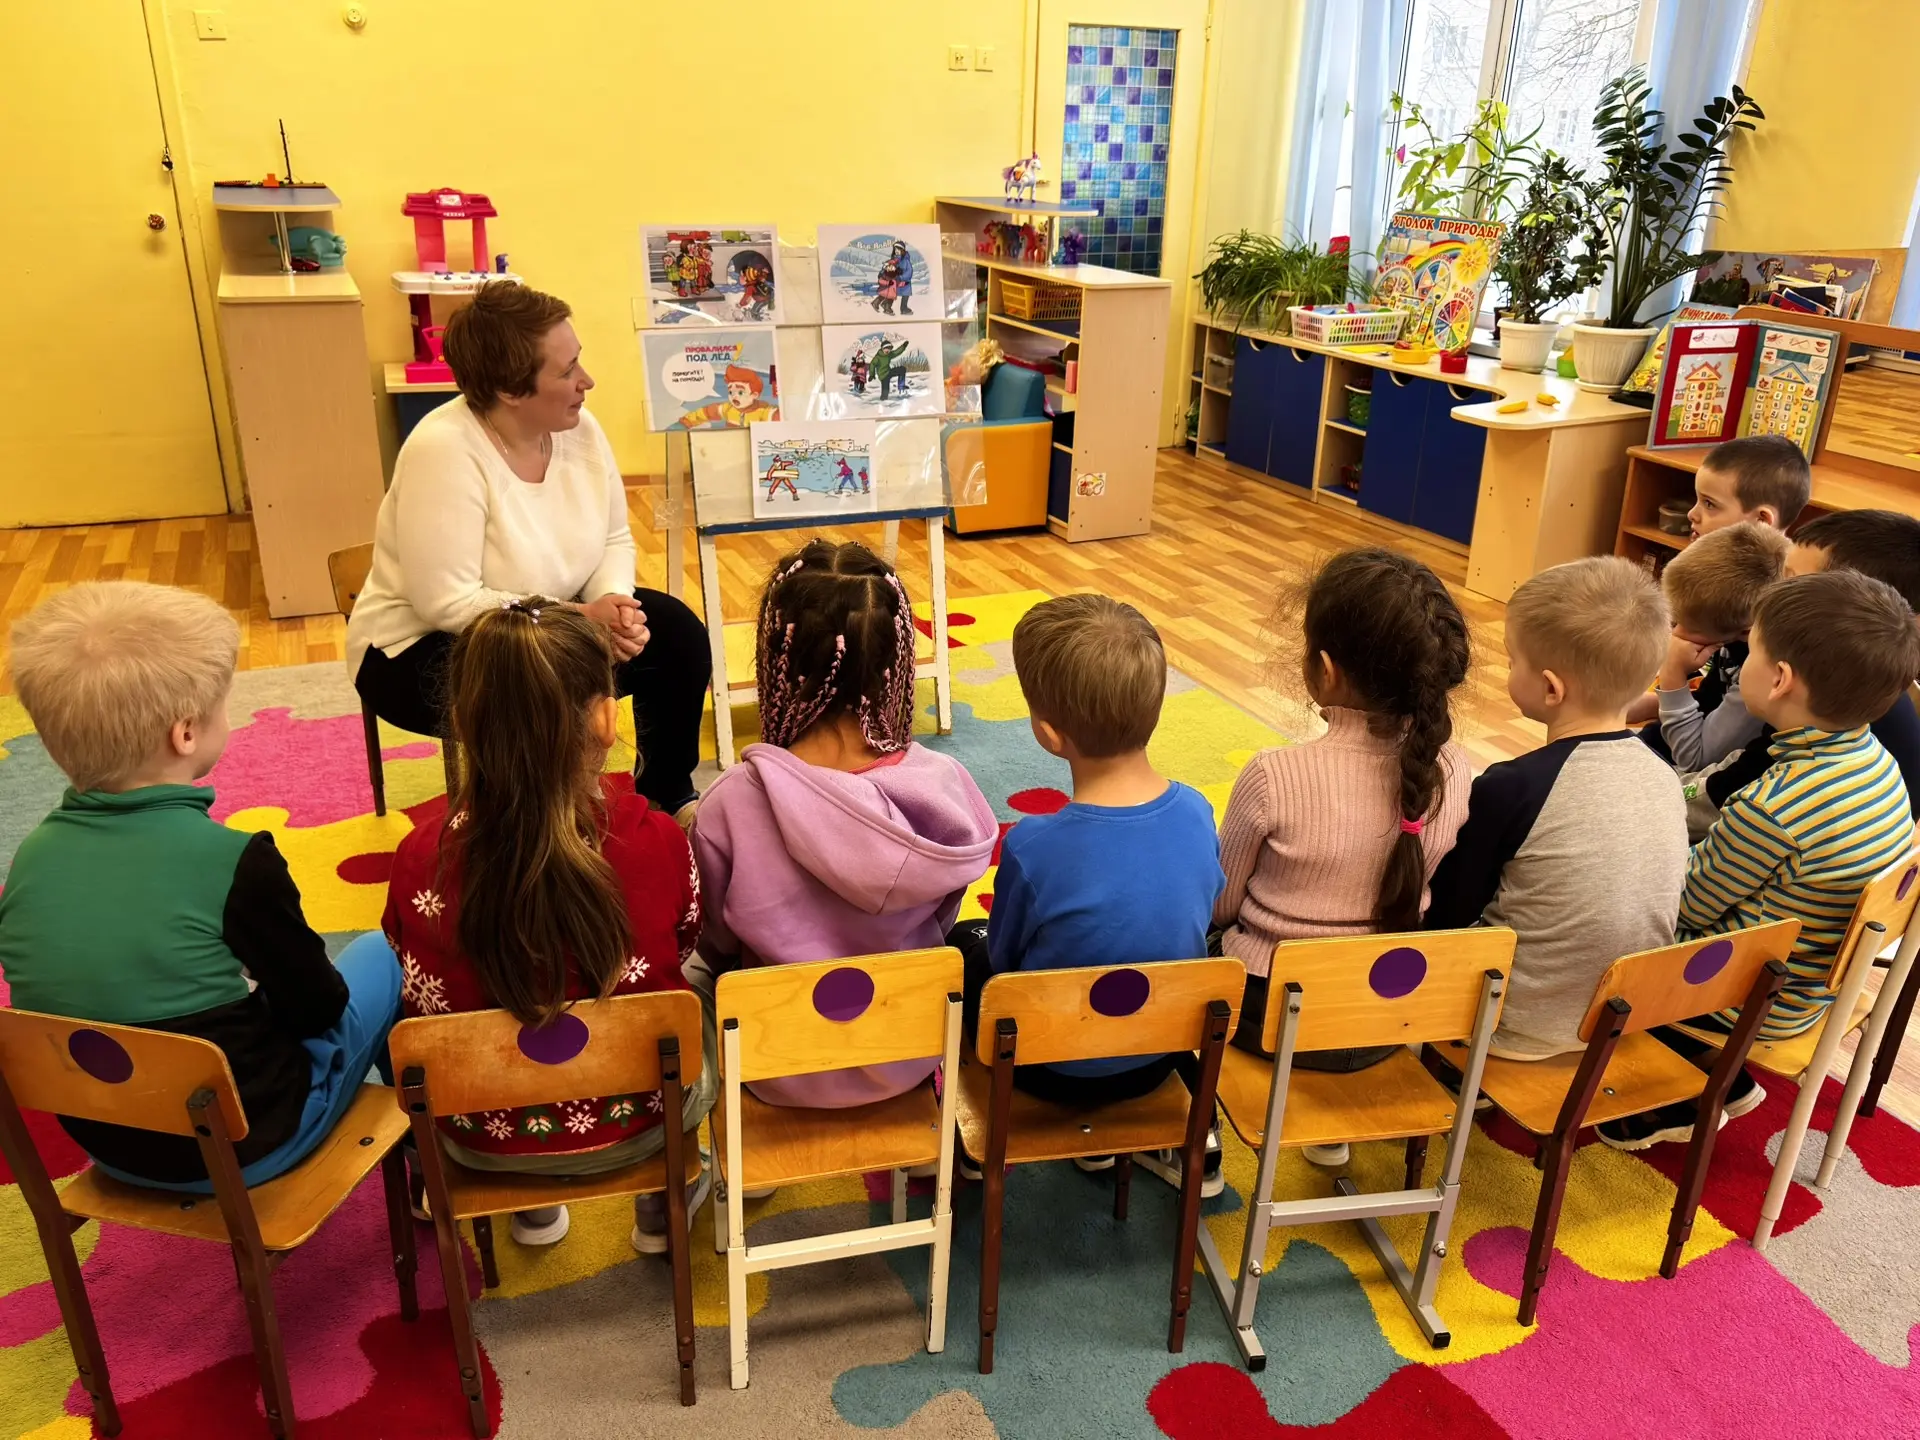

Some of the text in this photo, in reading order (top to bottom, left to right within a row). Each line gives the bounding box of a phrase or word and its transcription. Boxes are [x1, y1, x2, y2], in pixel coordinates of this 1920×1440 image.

[1393, 215, 1500, 238] УГОЛОК ПРИРОДЫ
[1676, 307, 1730, 320] ДИНОЗАВР
[685, 345, 738, 353] ПРОВАЛИЛСЯ
[686, 354, 708, 362] ПОД
